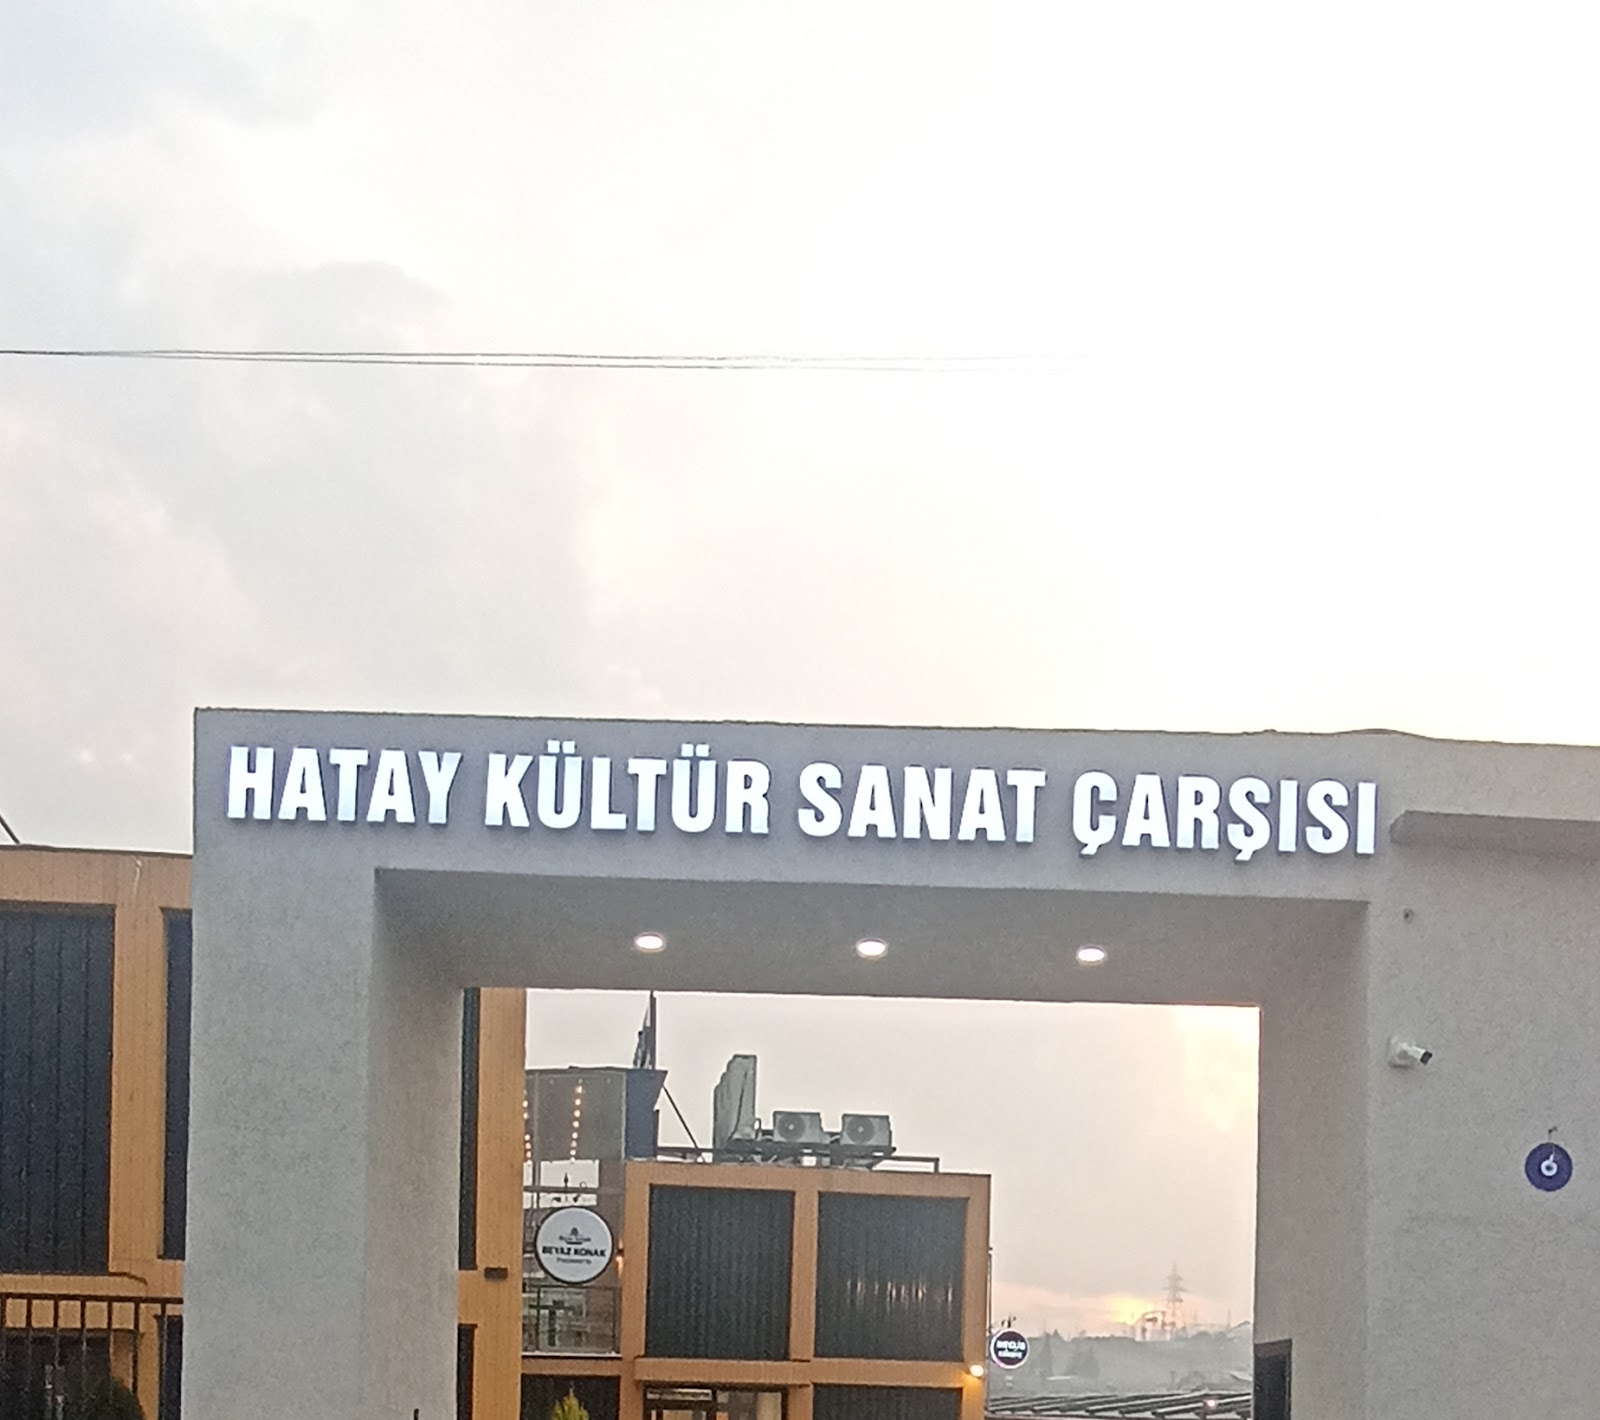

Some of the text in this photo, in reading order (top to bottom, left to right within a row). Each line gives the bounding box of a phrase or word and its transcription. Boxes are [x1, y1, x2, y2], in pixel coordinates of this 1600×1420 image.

[227, 740, 1378, 862] HATAY KÜLTÜR SANAT ÇARŞISI
[574, 1247, 606, 1256] KONAK
